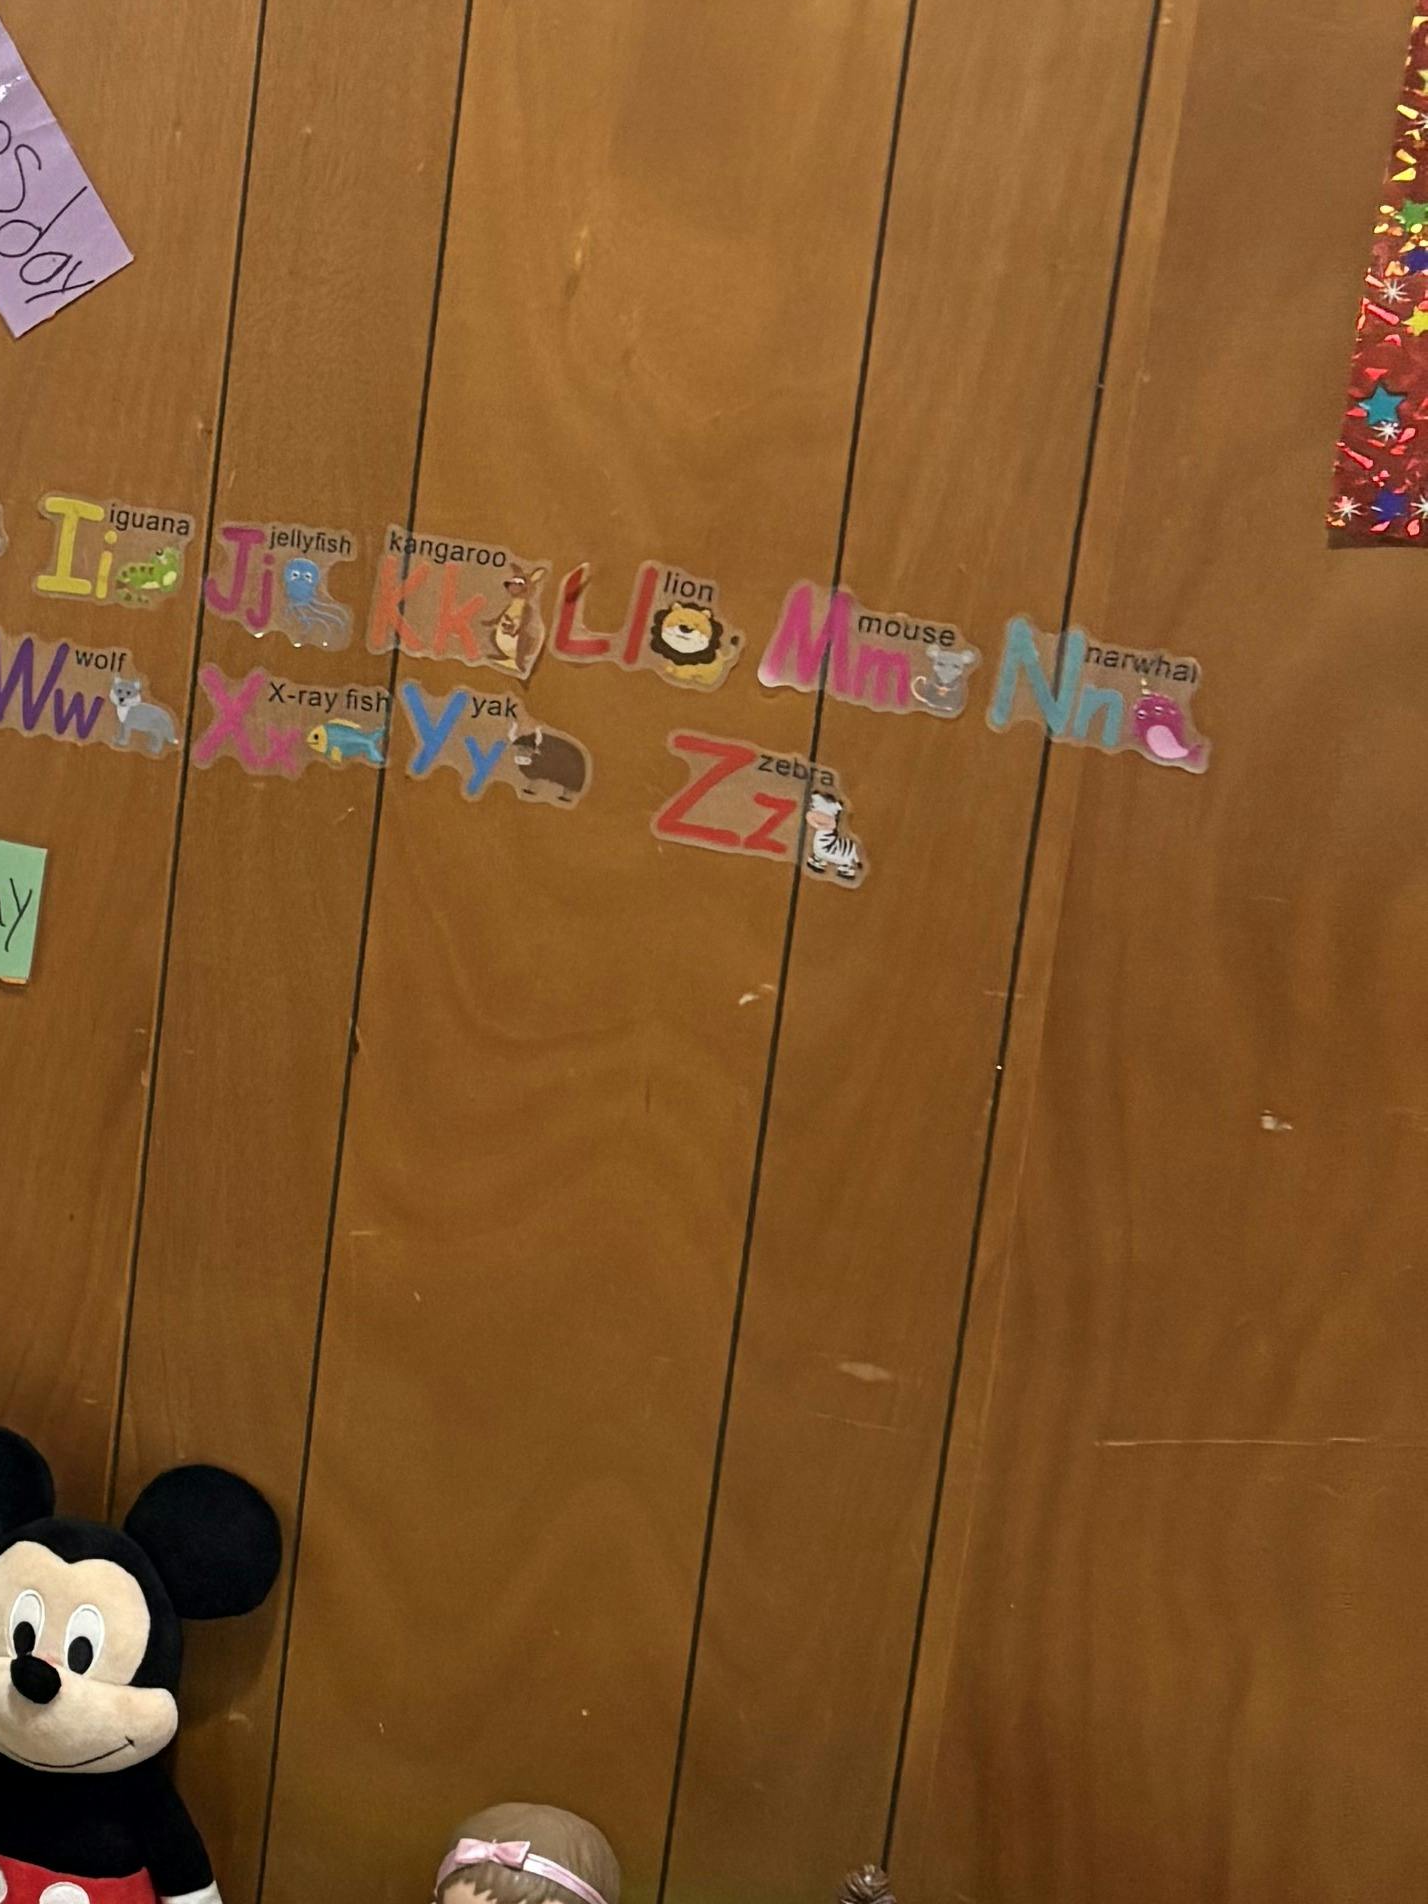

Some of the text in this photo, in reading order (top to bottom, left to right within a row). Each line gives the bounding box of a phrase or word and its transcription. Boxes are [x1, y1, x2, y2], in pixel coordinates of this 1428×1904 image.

[108, 504, 191, 537] iguana
[268, 524, 353, 559] jellyfish
[388, 529, 508, 571] kangaroo
[661, 570, 715, 604] lion
[1082, 640, 1198, 686] narwhal
[268, 681, 340, 718] X-ray
[756, 750, 837, 789] zebra
